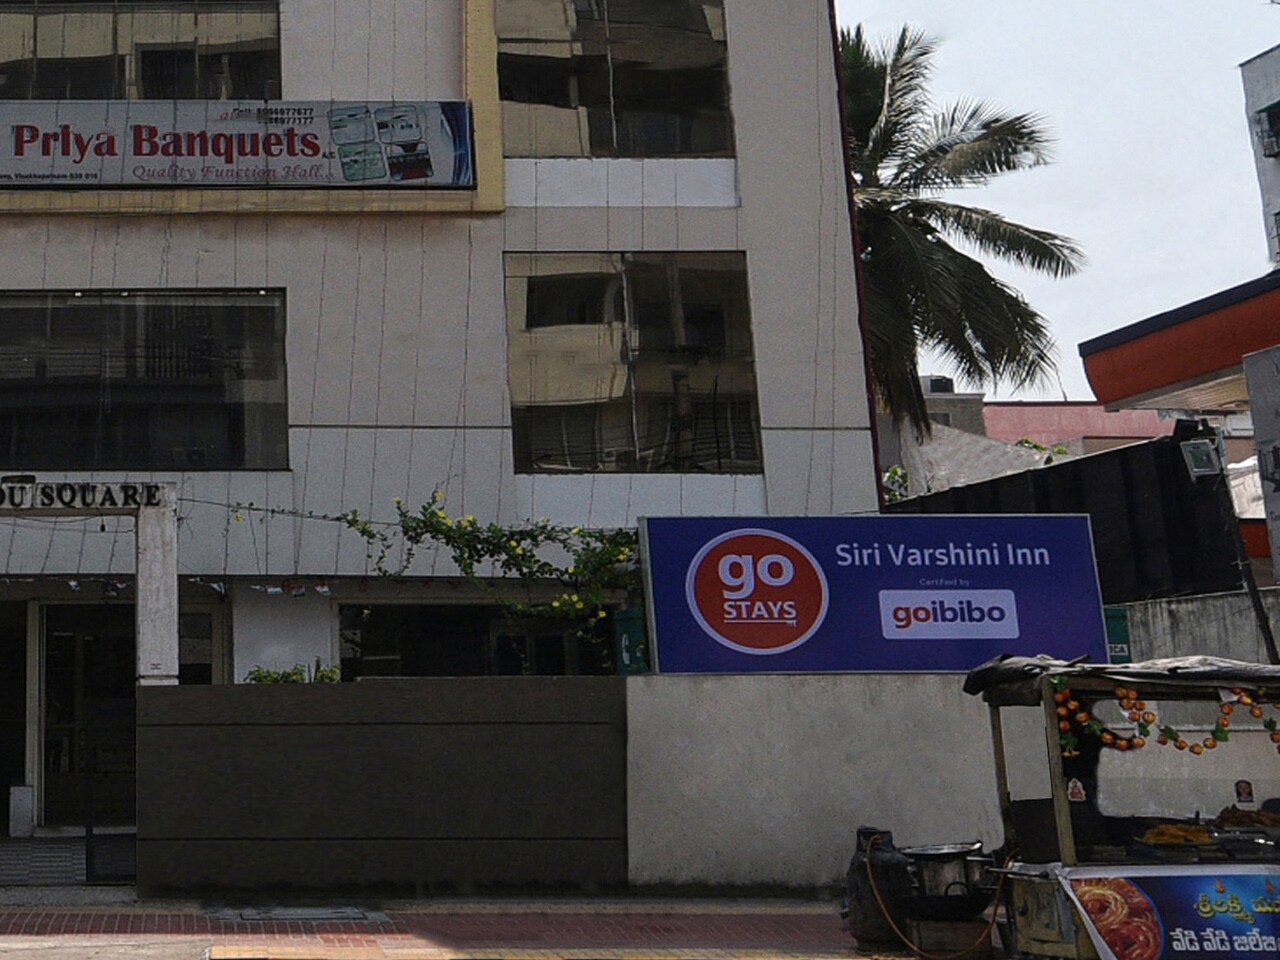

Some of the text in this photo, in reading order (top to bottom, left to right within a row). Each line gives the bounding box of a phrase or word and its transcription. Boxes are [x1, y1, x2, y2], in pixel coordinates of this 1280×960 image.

[11, 124, 118, 164] Priya
[130, 124, 321, 165] Banquets
[132, 164, 196, 182] Quality
[200, 165, 277, 180] Function
[41, 483, 162, 508] SQUARE
[835, 542, 1051, 567] Siri Varshini Inn
[718, 552, 795, 599] go
[723, 600, 798, 620] STAYS
[892, 599, 1007, 628] goibibo
